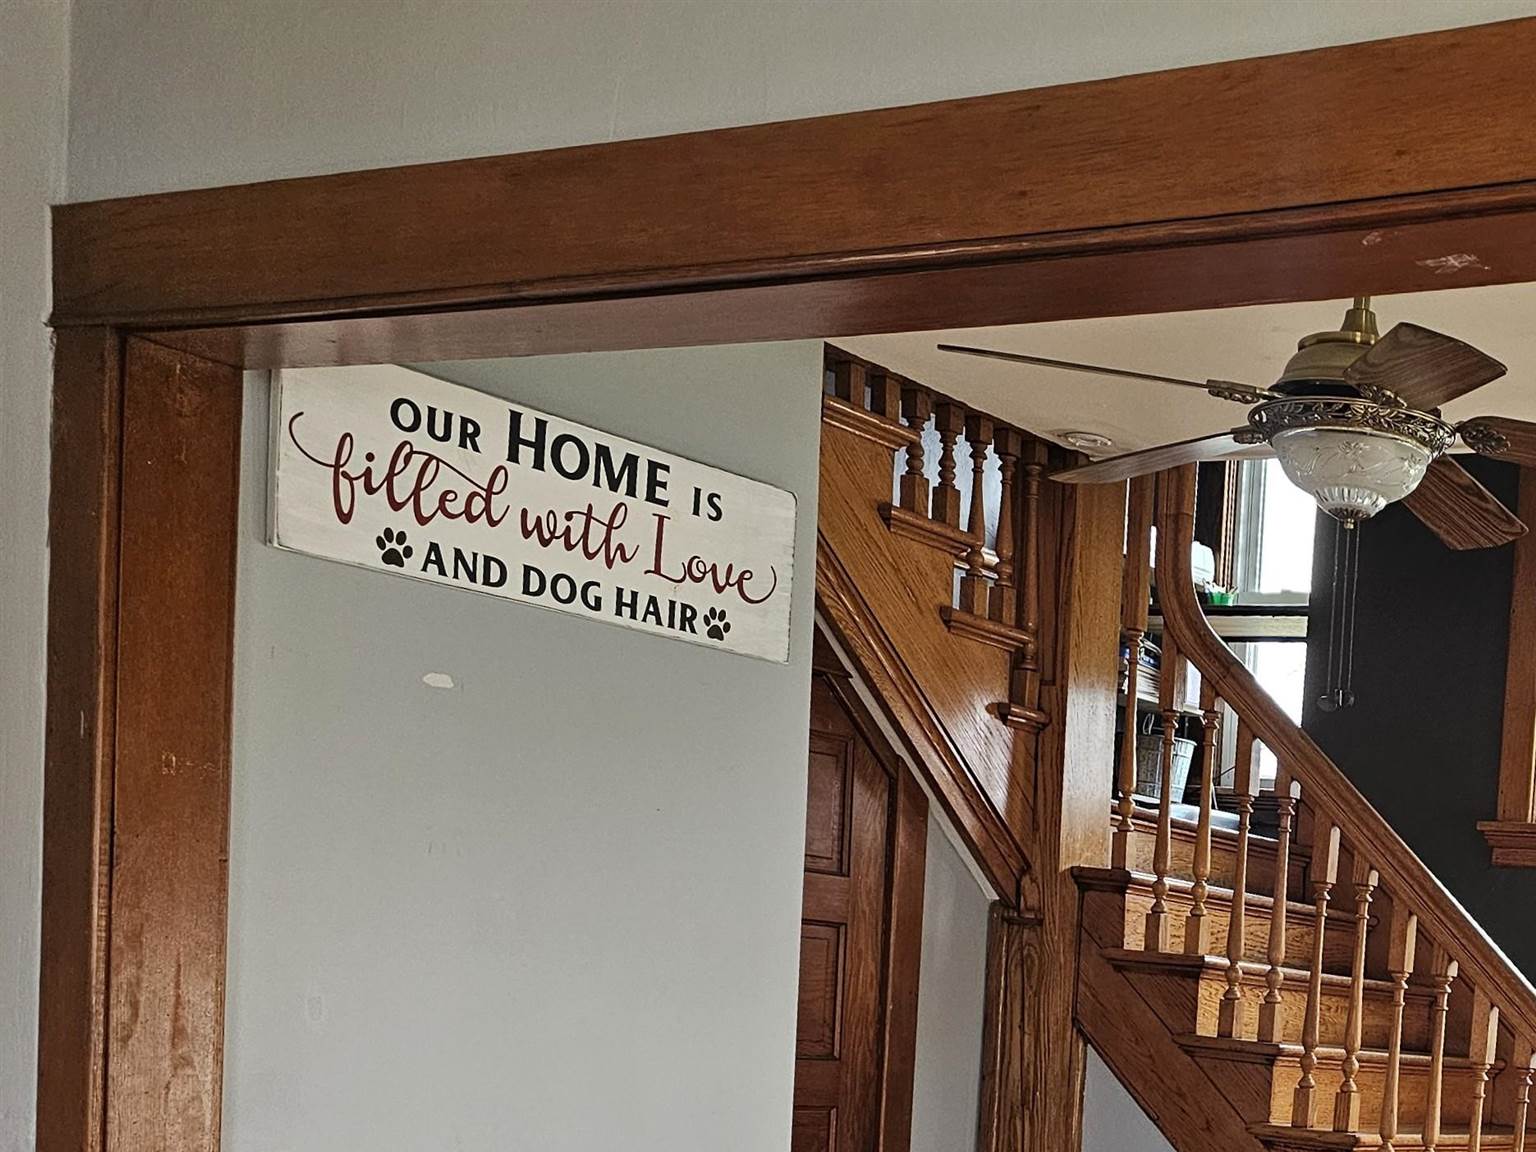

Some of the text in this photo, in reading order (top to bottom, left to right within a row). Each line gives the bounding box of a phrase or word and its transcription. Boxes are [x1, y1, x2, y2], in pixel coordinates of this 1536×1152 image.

[289, 411, 777, 604] filled with Love
[390, 398, 723, 522] OUR HOME IS
[421, 542, 698, 635] AND DOG HAIR
